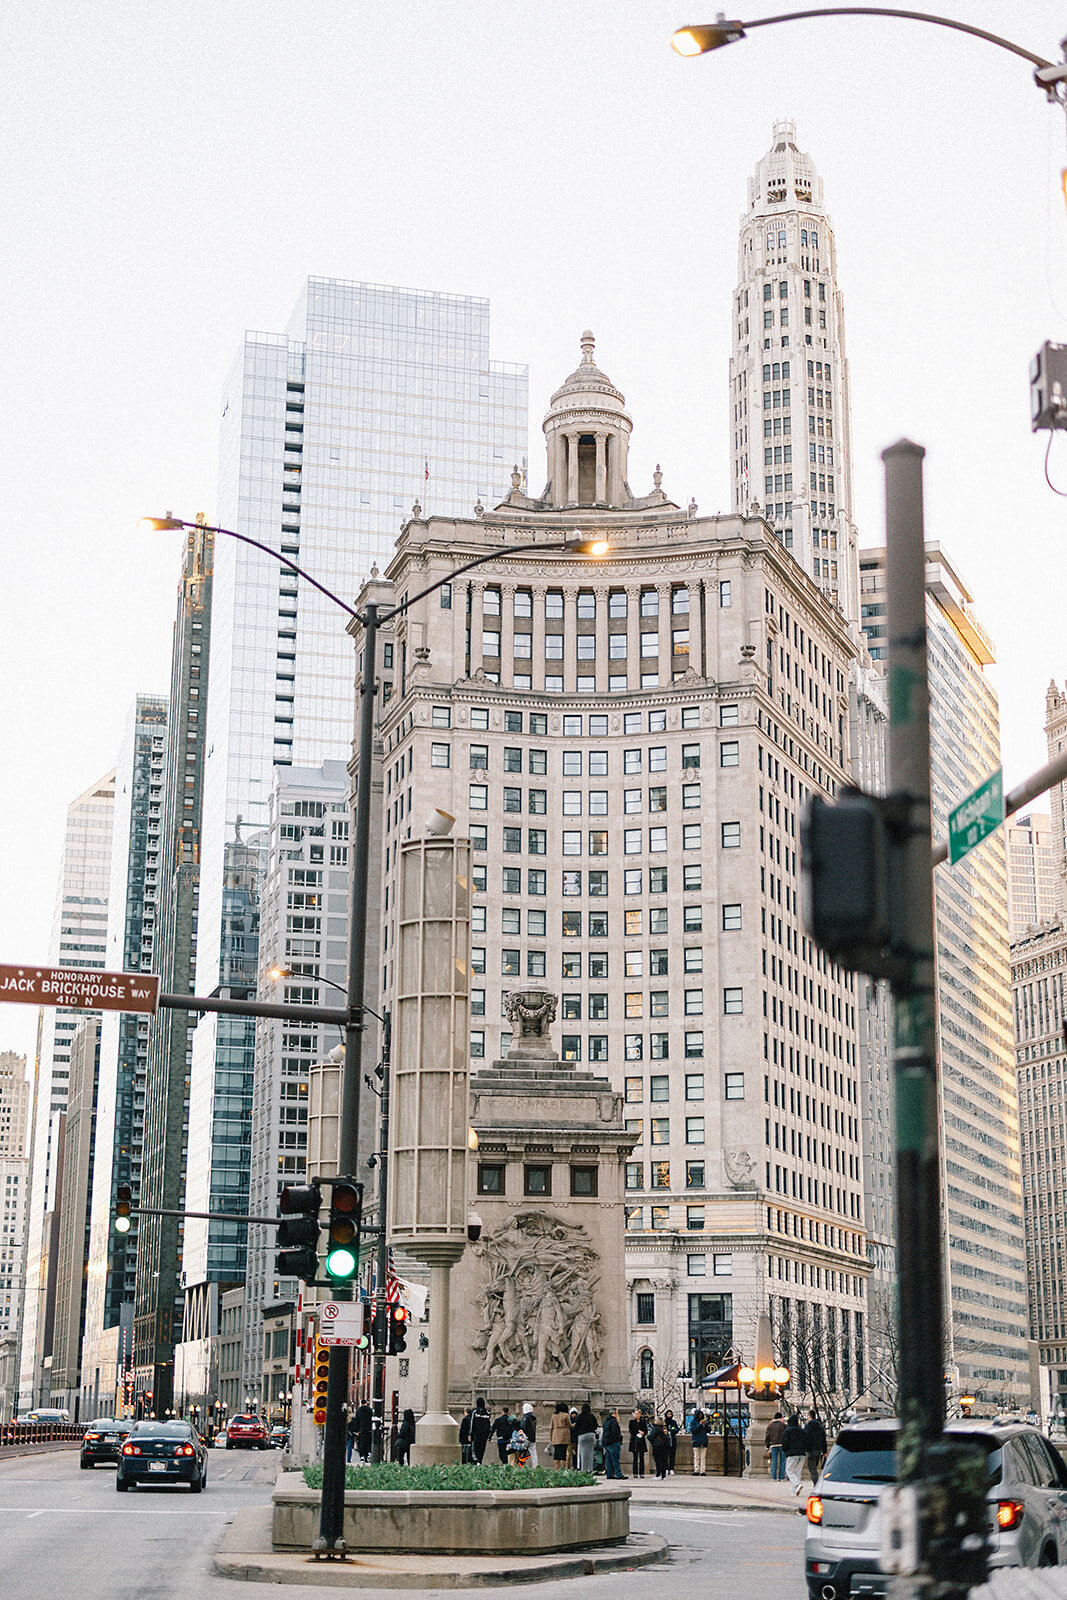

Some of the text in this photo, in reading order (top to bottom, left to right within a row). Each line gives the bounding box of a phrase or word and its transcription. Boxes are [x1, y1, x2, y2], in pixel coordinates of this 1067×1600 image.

[51, 971, 103, 983] HONORARY
[0, 977, 151, 999] JACK BRICKHOUSE WAY
[56, 995, 93, 1006] 410 N
